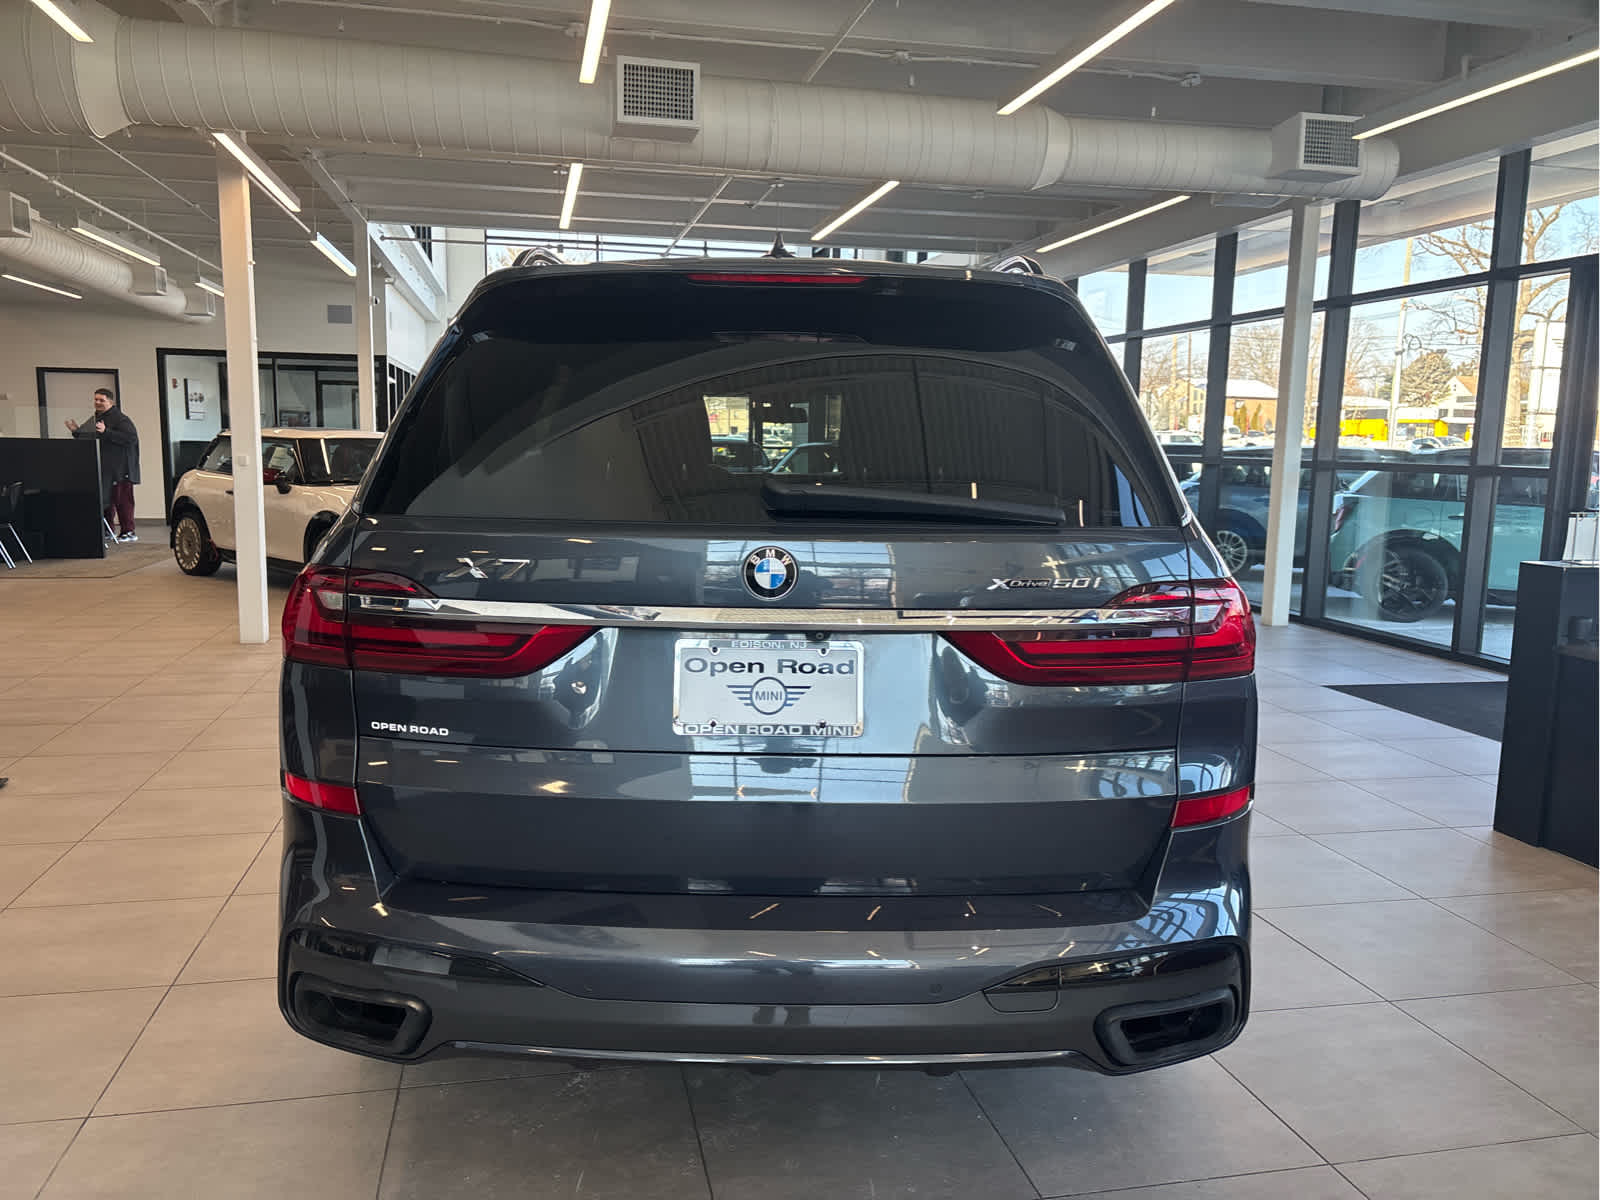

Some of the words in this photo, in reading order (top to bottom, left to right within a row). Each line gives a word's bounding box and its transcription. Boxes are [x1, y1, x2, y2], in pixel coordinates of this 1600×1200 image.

[750, 549, 792, 565] BMW
[445, 557, 530, 579] X7
[731, 640, 785, 649] EDISON,
[790, 640, 807, 649] NJ
[684, 657, 765, 677] Open
[777, 659, 855, 675] Road
[755, 691, 783, 701] MINI
[371, 721, 407, 732] OPEN
[410, 725, 449, 736] ROAD
[685, 724, 739, 735] OPEN
[746, 725, 803, 736] ROAD
[809, 725, 852, 736] MINI
